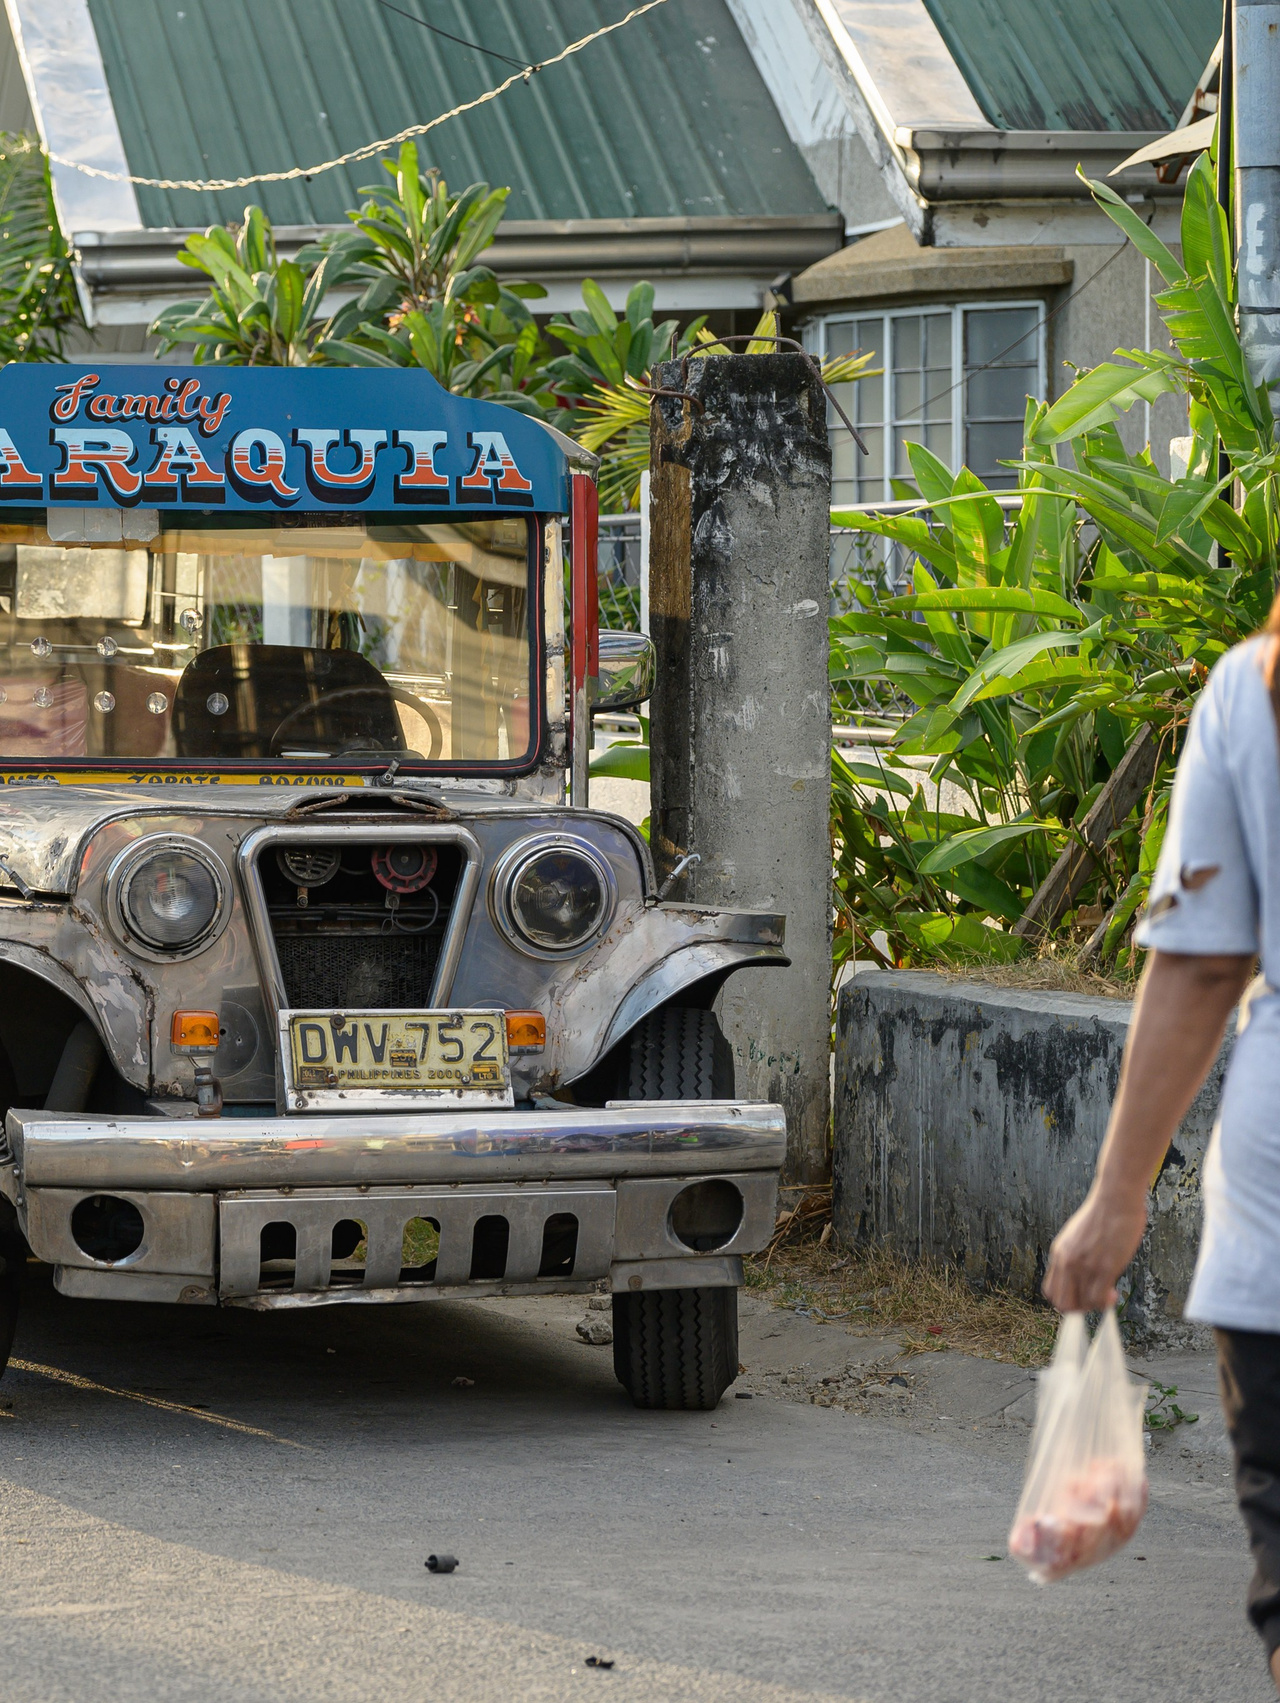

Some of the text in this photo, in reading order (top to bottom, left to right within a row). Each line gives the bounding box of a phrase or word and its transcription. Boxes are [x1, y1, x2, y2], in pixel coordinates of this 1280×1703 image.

[51, 374, 232, 435] Family
[300, 1022, 497, 1063] DWV 752
[338, 1068, 421, 1080] PHILIPPINES
[428, 1068, 462, 1080] 2000
